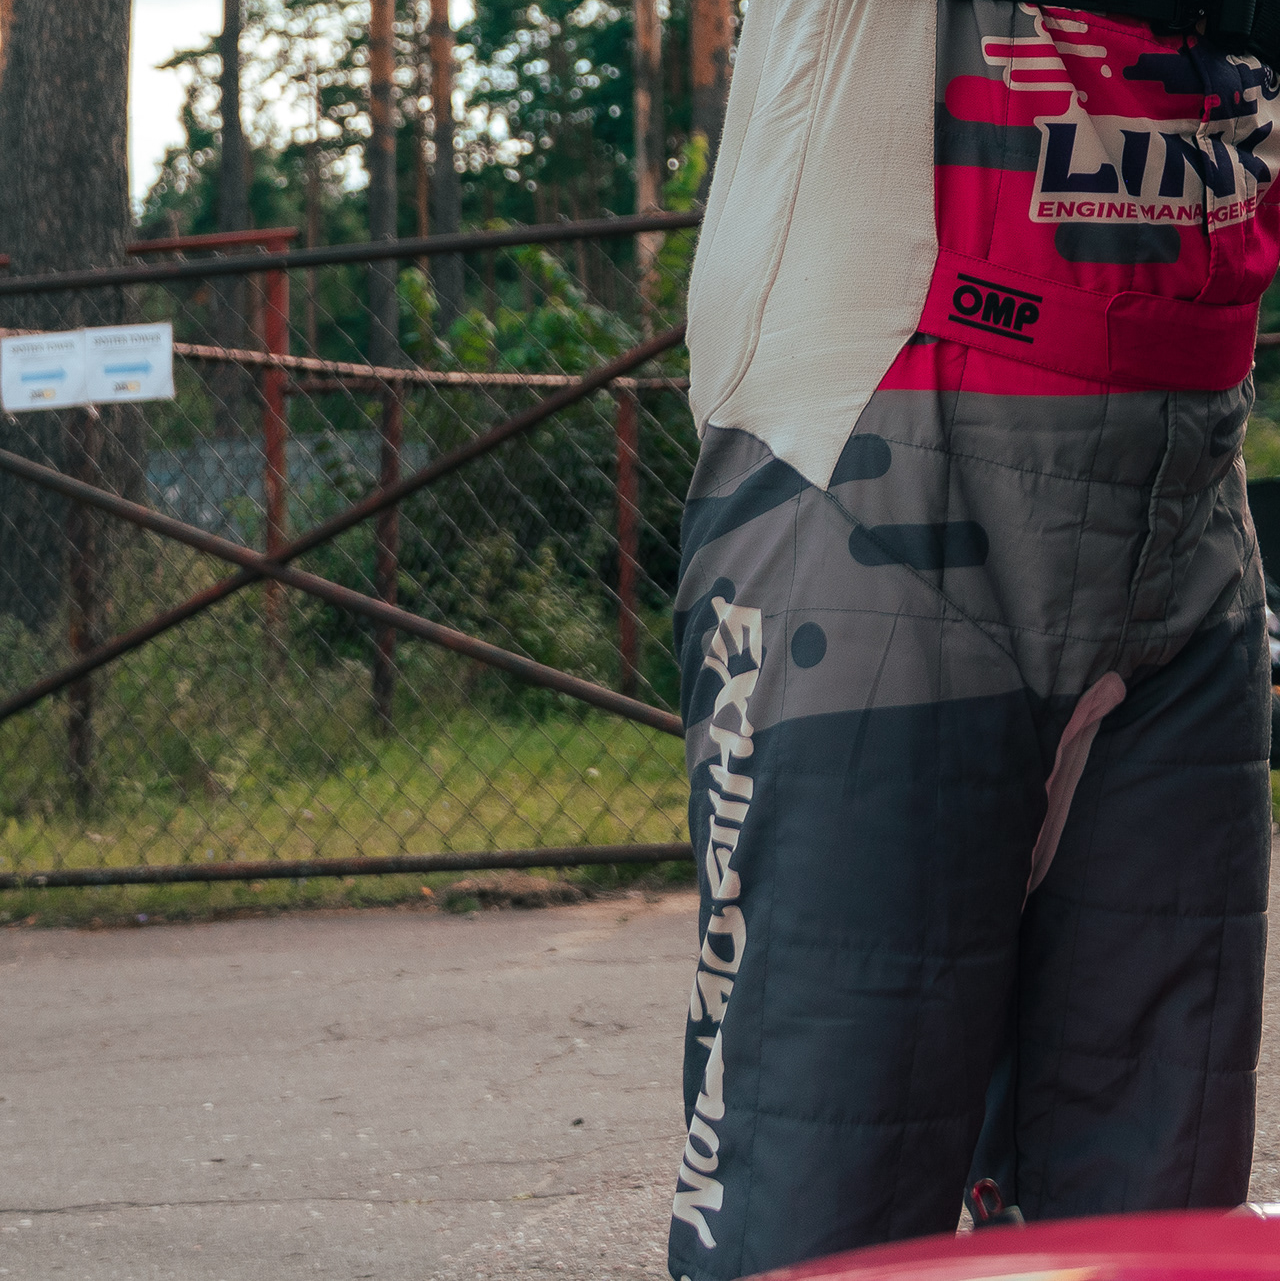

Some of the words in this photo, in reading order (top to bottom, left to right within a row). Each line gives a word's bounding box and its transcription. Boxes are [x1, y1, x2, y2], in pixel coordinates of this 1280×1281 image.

[1040, 120, 1274, 199] LINK
[1037, 200, 1138, 219] ENGINE
[952, 283, 1040, 332] OMP
